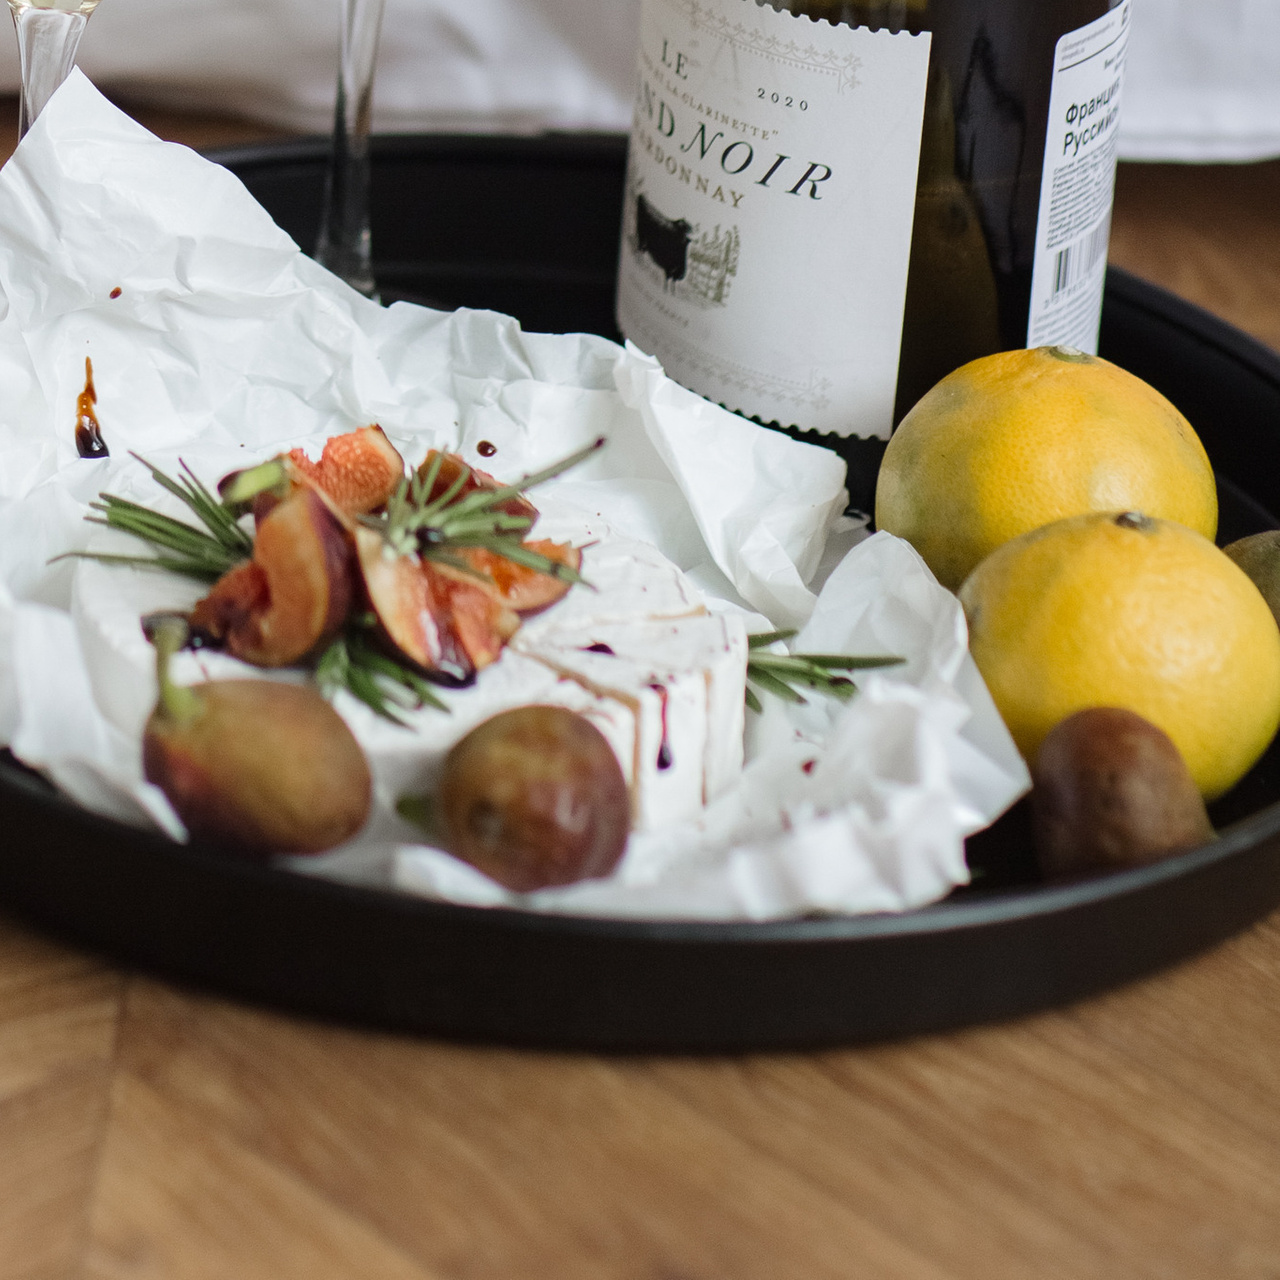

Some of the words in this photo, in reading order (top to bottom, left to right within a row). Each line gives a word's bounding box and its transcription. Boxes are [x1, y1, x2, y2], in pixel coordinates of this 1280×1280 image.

[661, 39, 688, 80] LE
[757, 87, 809, 112] 2020
[680, 121, 833, 201] NOIR
